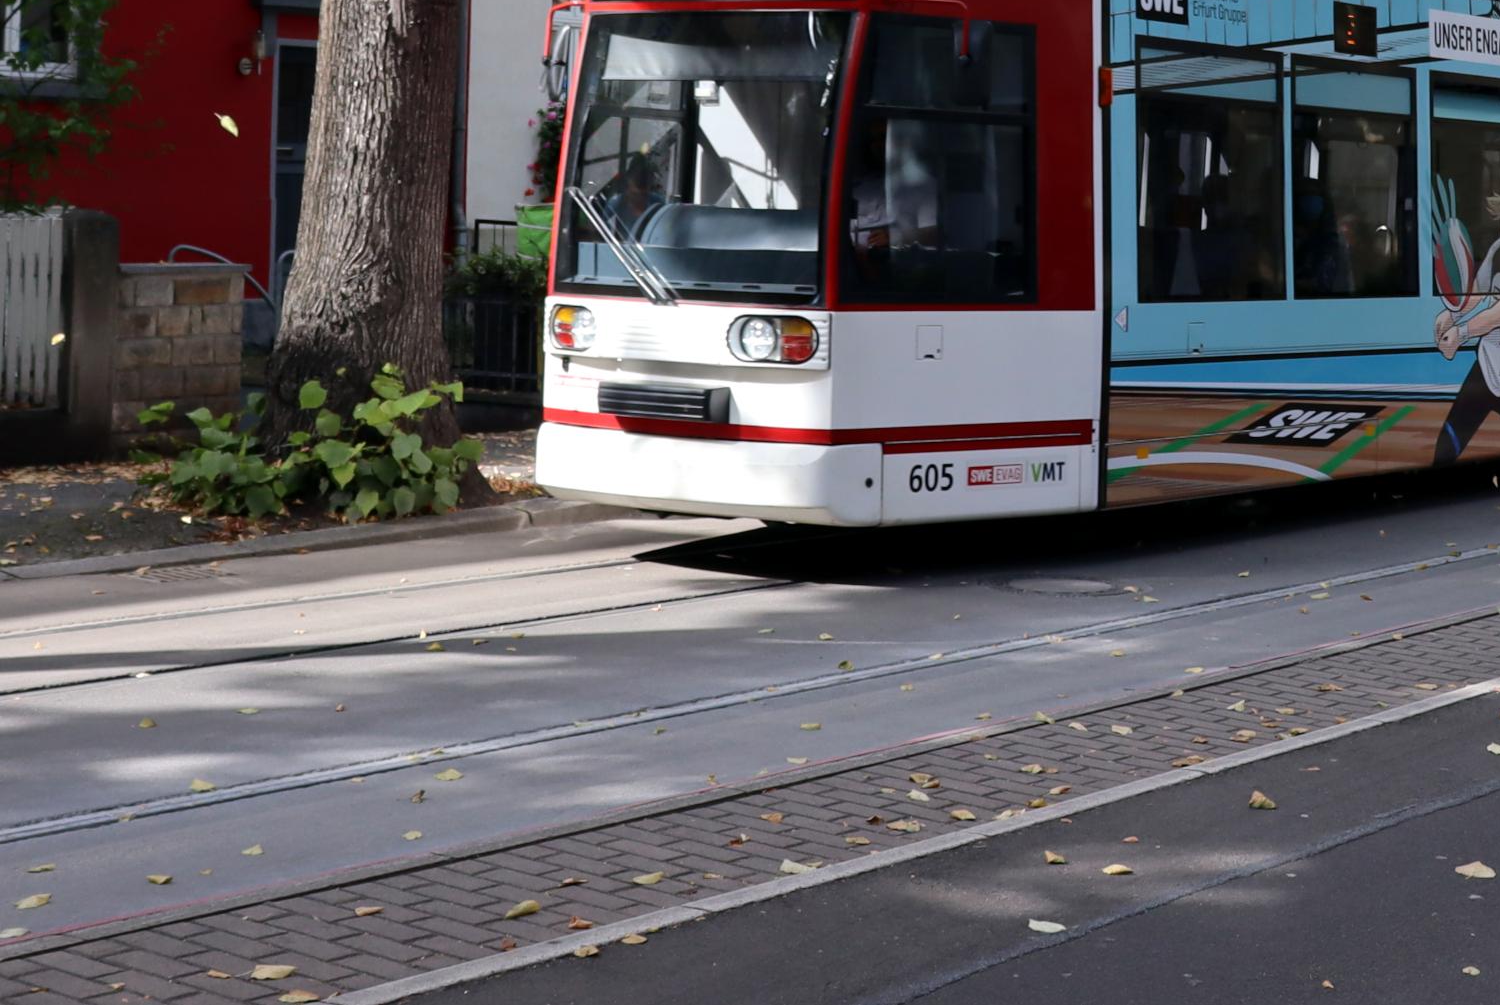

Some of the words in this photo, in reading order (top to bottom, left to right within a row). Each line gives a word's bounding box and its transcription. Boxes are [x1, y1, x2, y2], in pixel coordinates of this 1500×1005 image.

[1192, 0, 1217, 19] Erfurt
[1219, 5, 1247, 26] Gruppe
[1434, 21, 1473, 53] UNSER
[1248, 409, 1366, 440] SWE
[909, 463, 954, 493] 605
[970, 468, 993, 483] SWE
[995, 467, 1021, 482] EVAG
[1031, 461, 1065, 482] VMT
